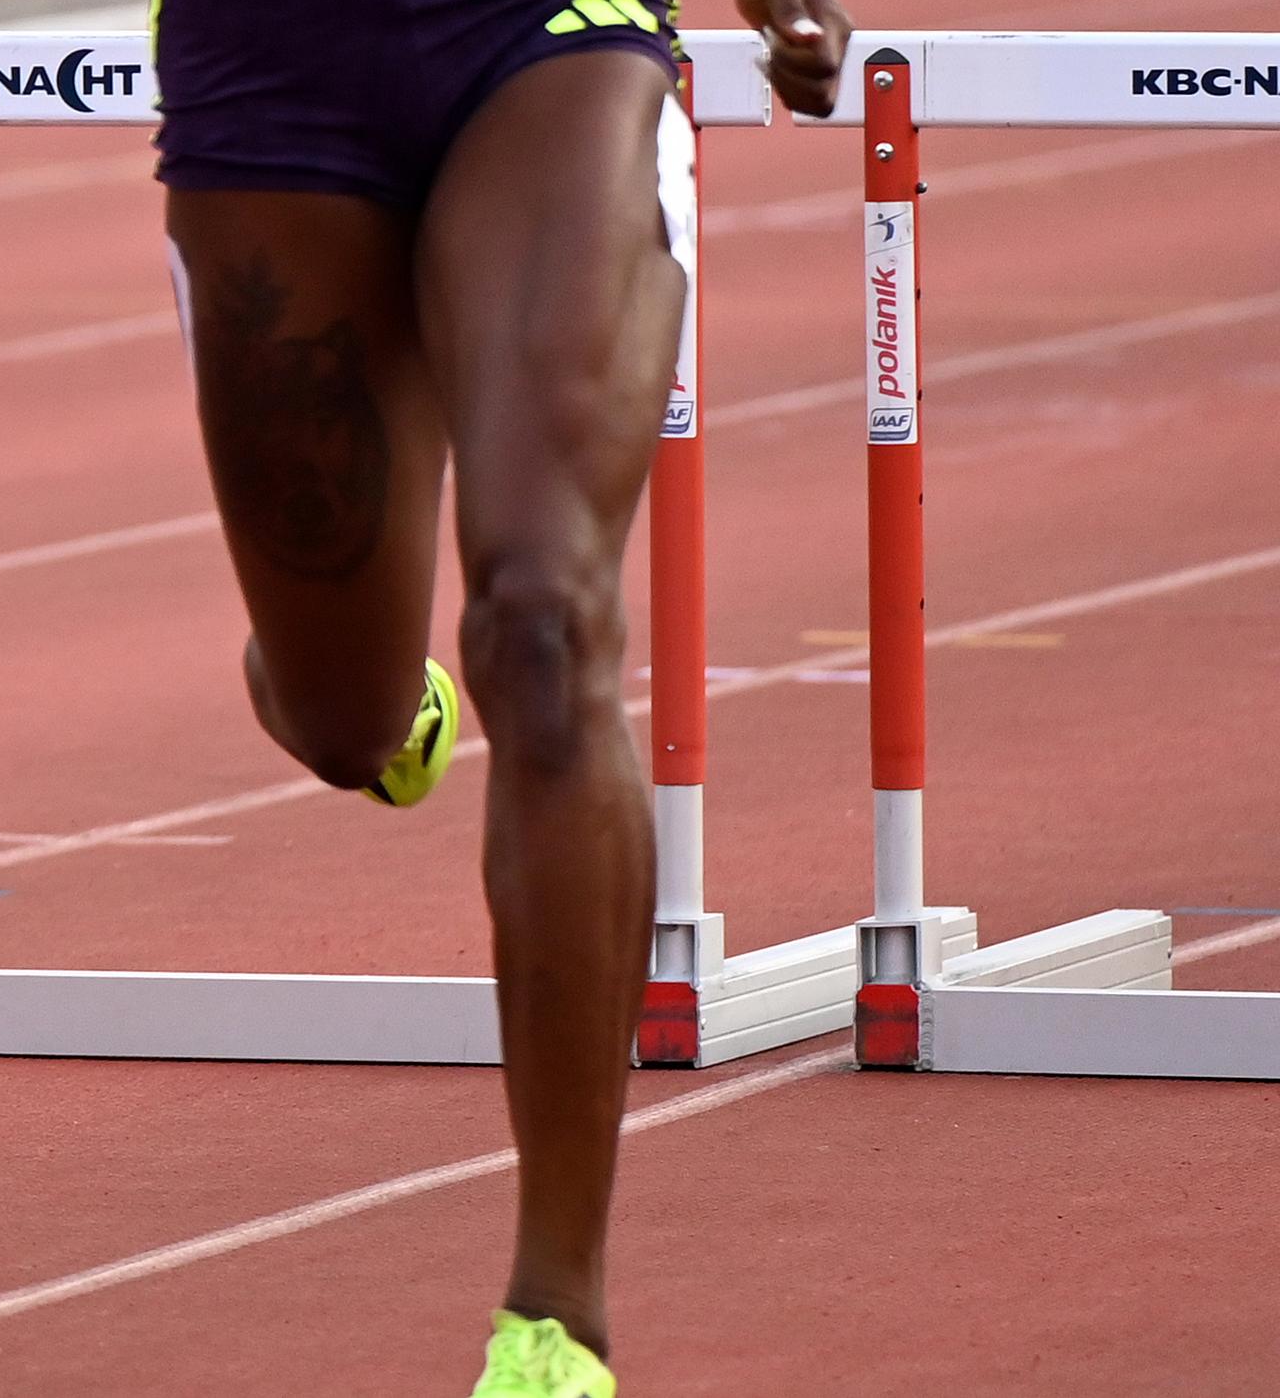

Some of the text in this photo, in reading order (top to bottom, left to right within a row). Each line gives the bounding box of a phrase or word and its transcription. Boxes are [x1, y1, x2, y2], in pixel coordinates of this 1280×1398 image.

[1132, 65, 1280, 97] KBC-N
[870, 264, 906, 400] polanik
[666, 408, 689, 421] AF
[873, 414, 910, 428] IAAF
